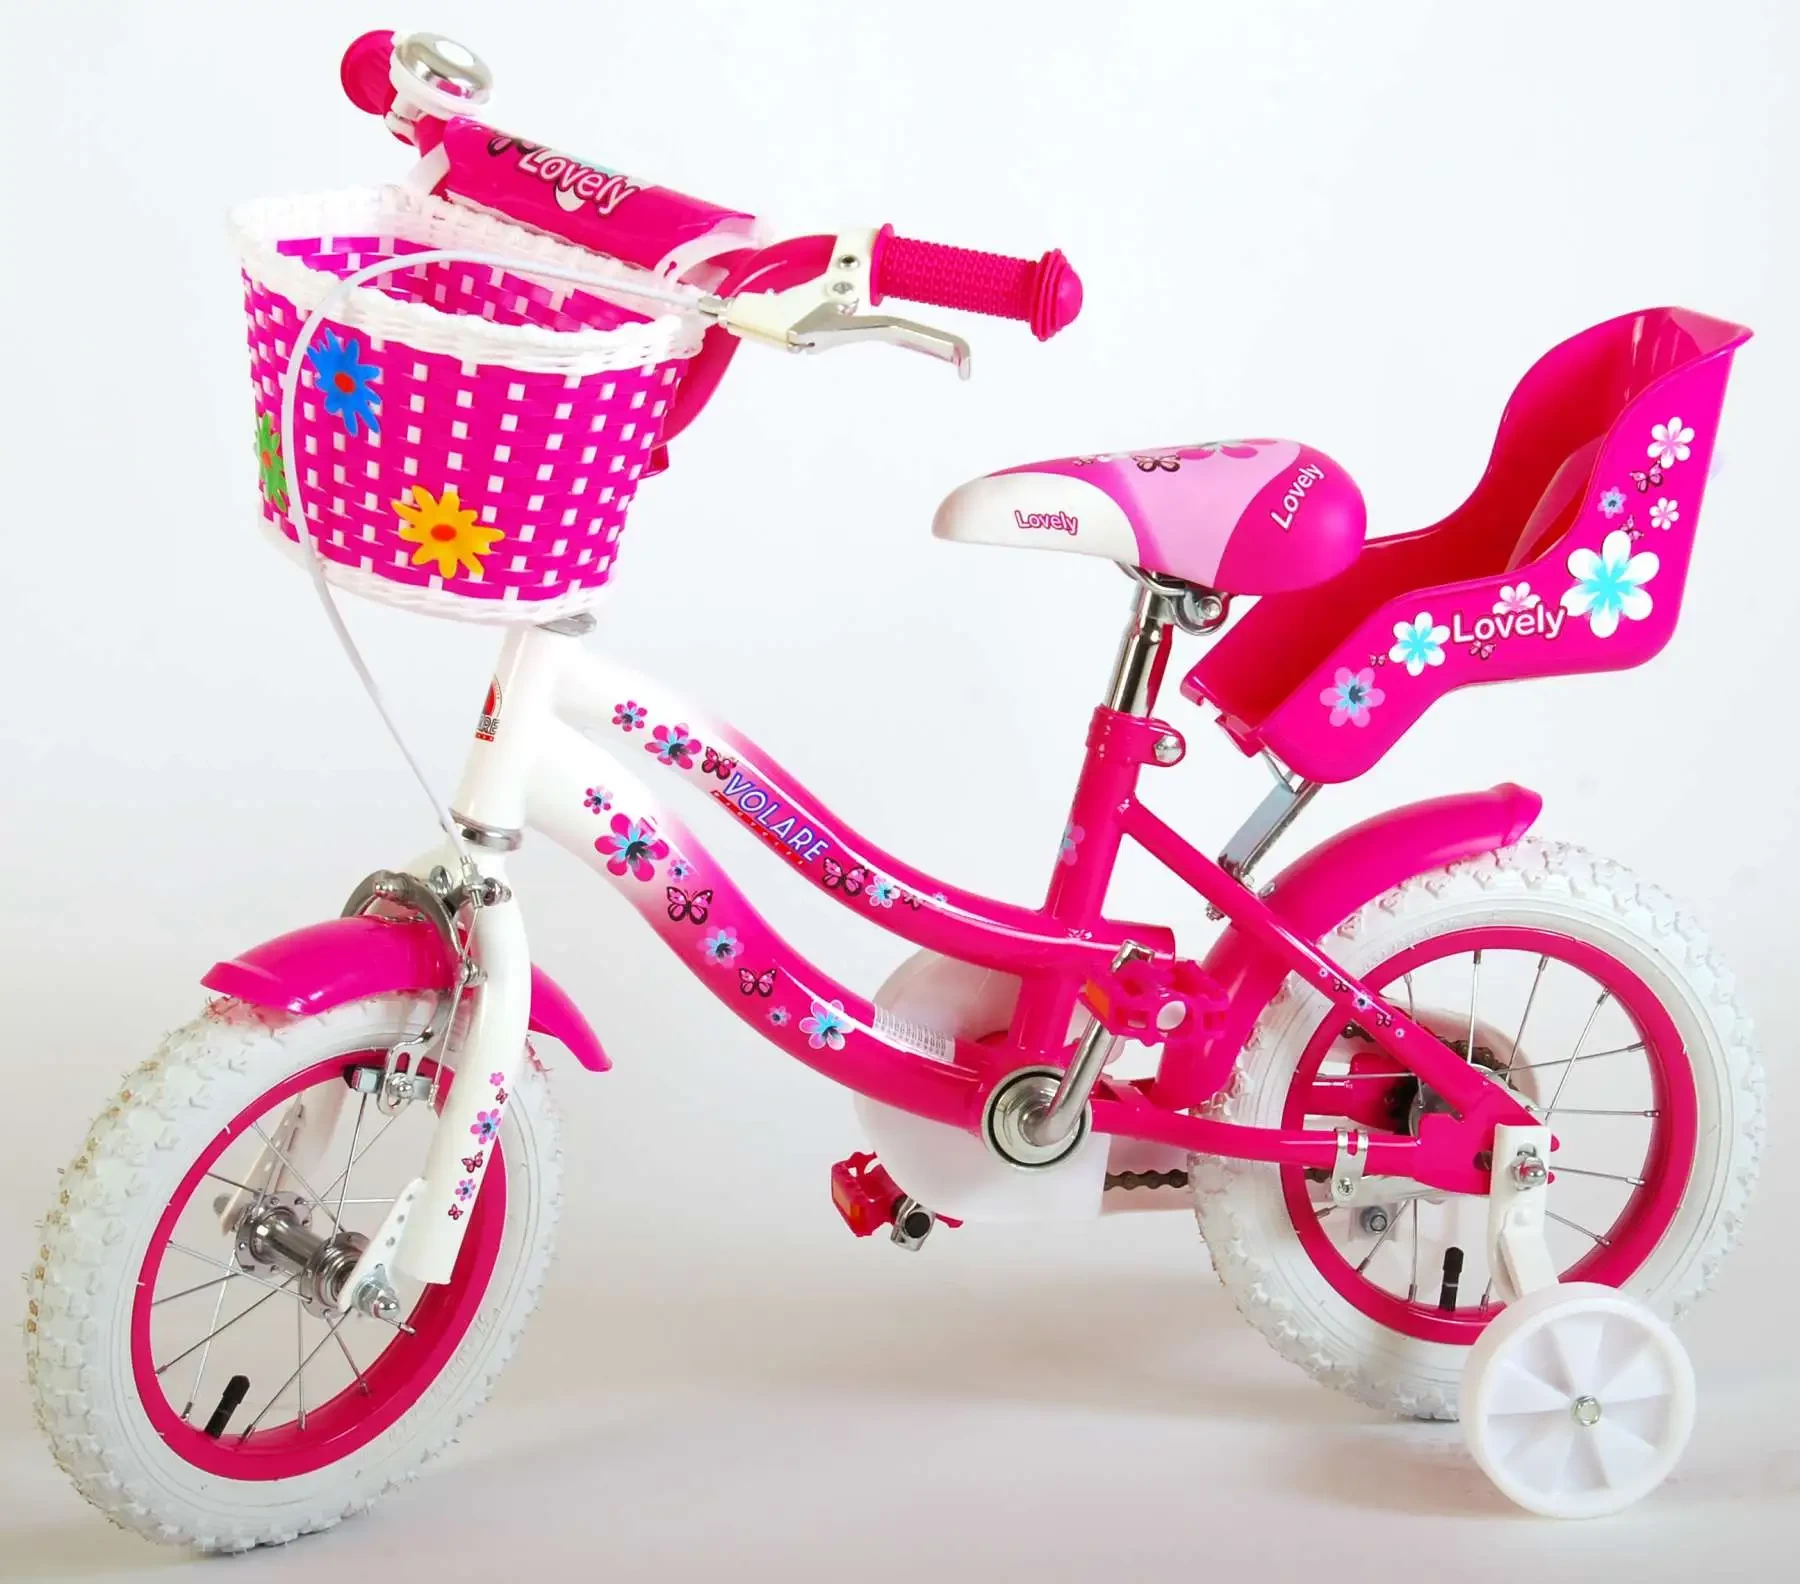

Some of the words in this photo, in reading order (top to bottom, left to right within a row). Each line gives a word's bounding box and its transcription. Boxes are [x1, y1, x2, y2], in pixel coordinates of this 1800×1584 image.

[516, 147, 639, 216] Lovely
[1014, 509, 1078, 536] Lovely
[1270, 463, 1325, 531] Lovely
[1452, 600, 1567, 641] Lovely
[723, 771, 829, 863] VOLARE
